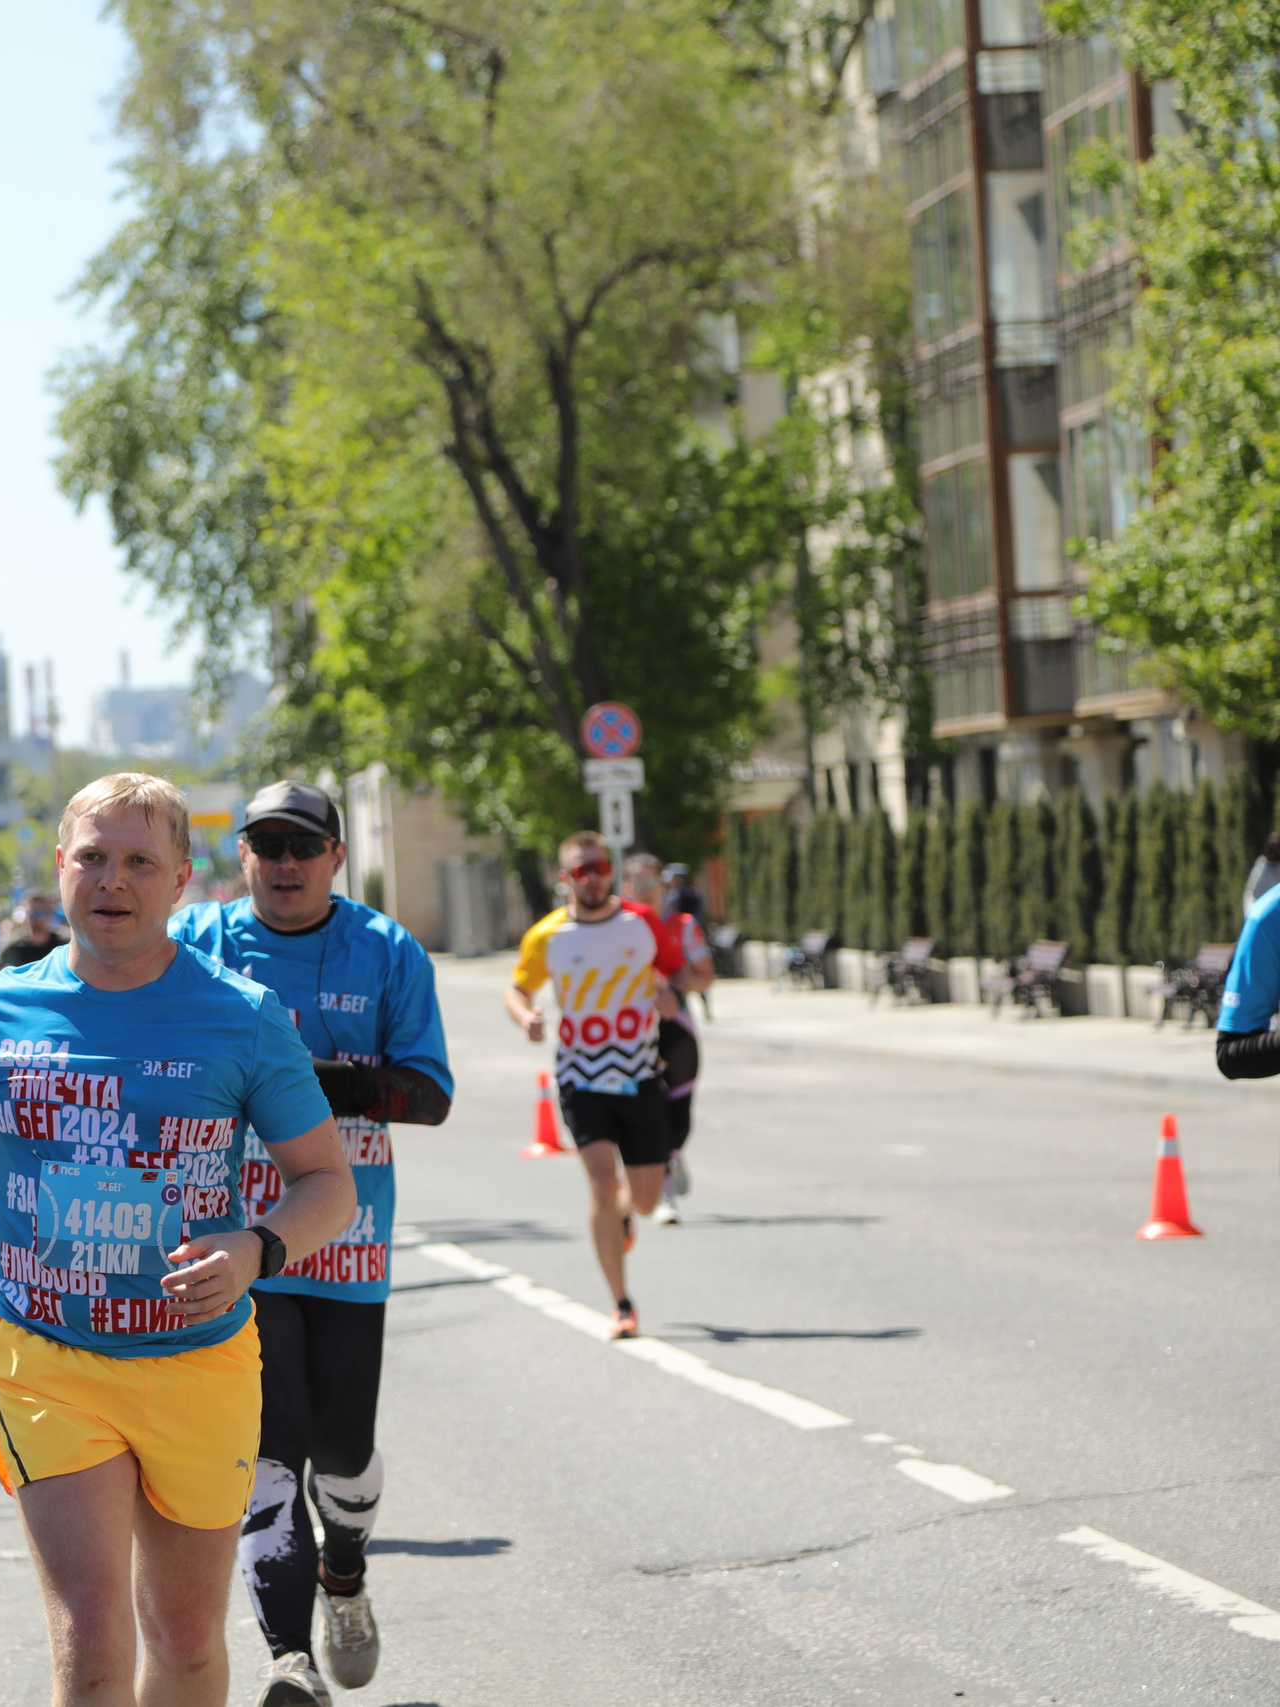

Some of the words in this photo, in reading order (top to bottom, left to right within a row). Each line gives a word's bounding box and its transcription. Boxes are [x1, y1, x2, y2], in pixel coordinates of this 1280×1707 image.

[8, 1068, 123, 1110] #МЕЧТА
[158, 1115, 238, 1152] #ЦЕЛЬ
[60, 1166, 81, 1176] ПСБ
[64, 1198, 153, 1240] 41403
